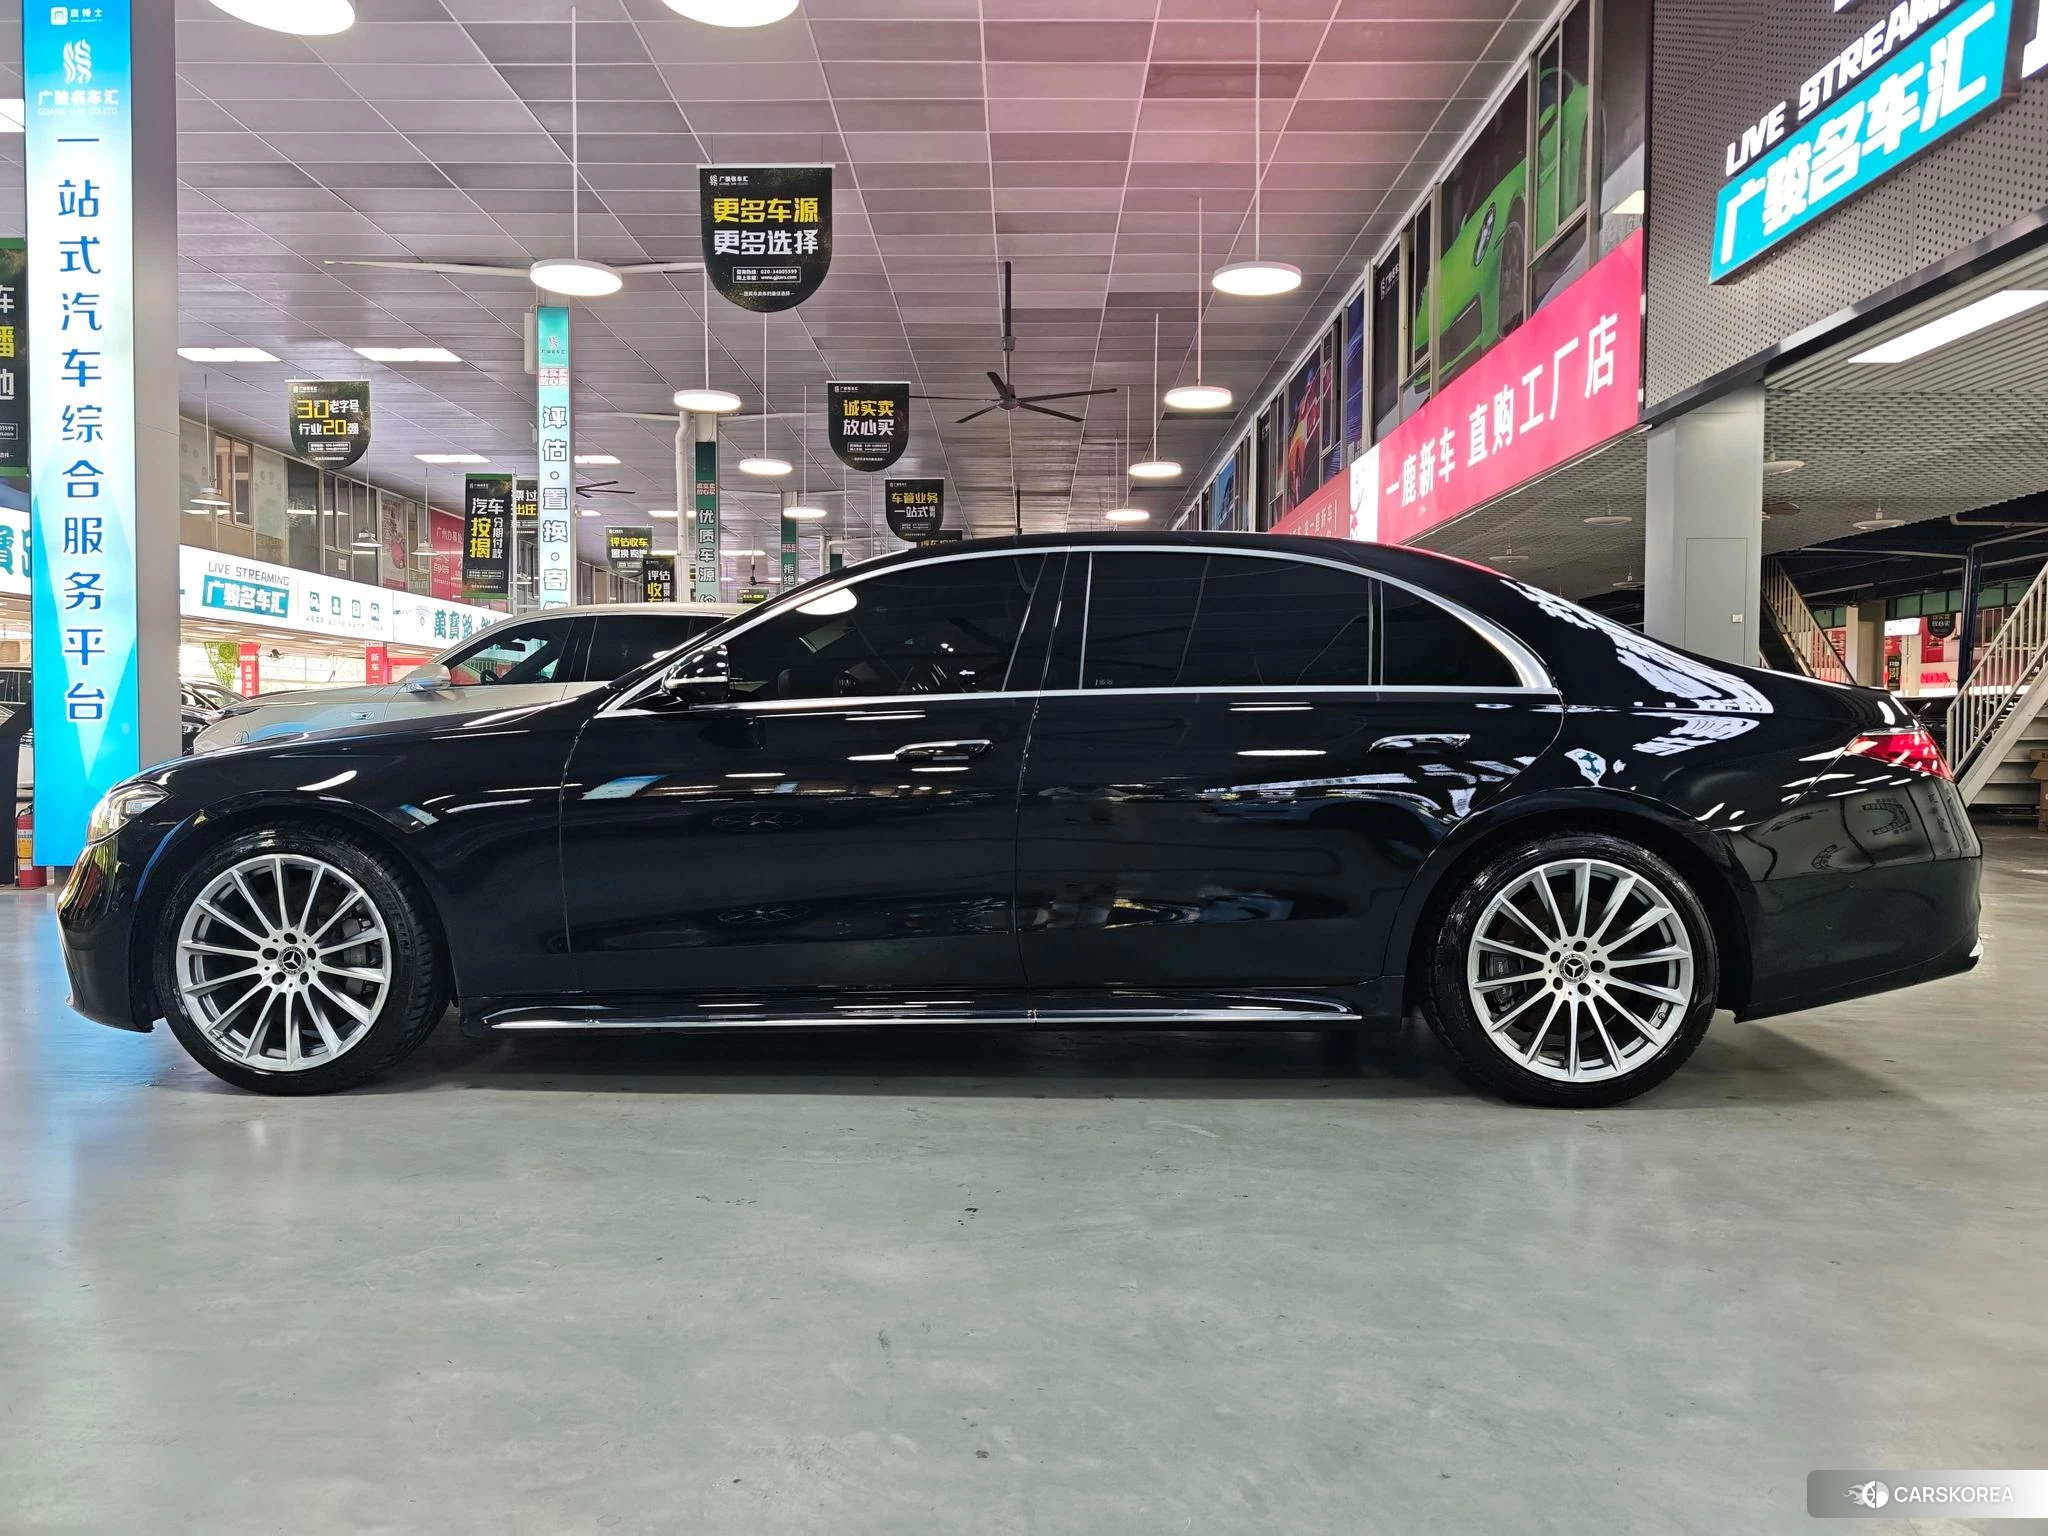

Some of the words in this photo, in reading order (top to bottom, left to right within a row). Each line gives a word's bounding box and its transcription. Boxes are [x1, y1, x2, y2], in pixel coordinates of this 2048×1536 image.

[1726, 101, 1786, 176] LIVE
[1798, 0, 1955, 120] STREAM
[1720, 1, 1996, 264] 广骏名车汇
[713, 198, 819, 223] 更多车源
[714, 229, 819, 255] 更多选择
[1386, 427, 1456, 508] 一鹿新车
[1468, 313, 1618, 467] 直购工厂店
[57, 137, 106, 721] 一站式汽车综合服务平台
[299, 419, 360, 435] 行业20强
[843, 419, 895, 436] 放心买
[472, 498, 504, 514] 汽车
[892, 492, 938, 504] 车管业务
[470, 517, 492, 559] 按揭
[492, 517, 504, 559] 分期付款
[610, 537, 648, 547] 评估收车
[699, 509, 716, 583] 优质车源
[208, 561, 230, 575] LIVE
[236, 566, 289, 586] STREAMING
[648, 570, 671, 581] 评估
[206, 580, 287, 614] 广骏名车汇
